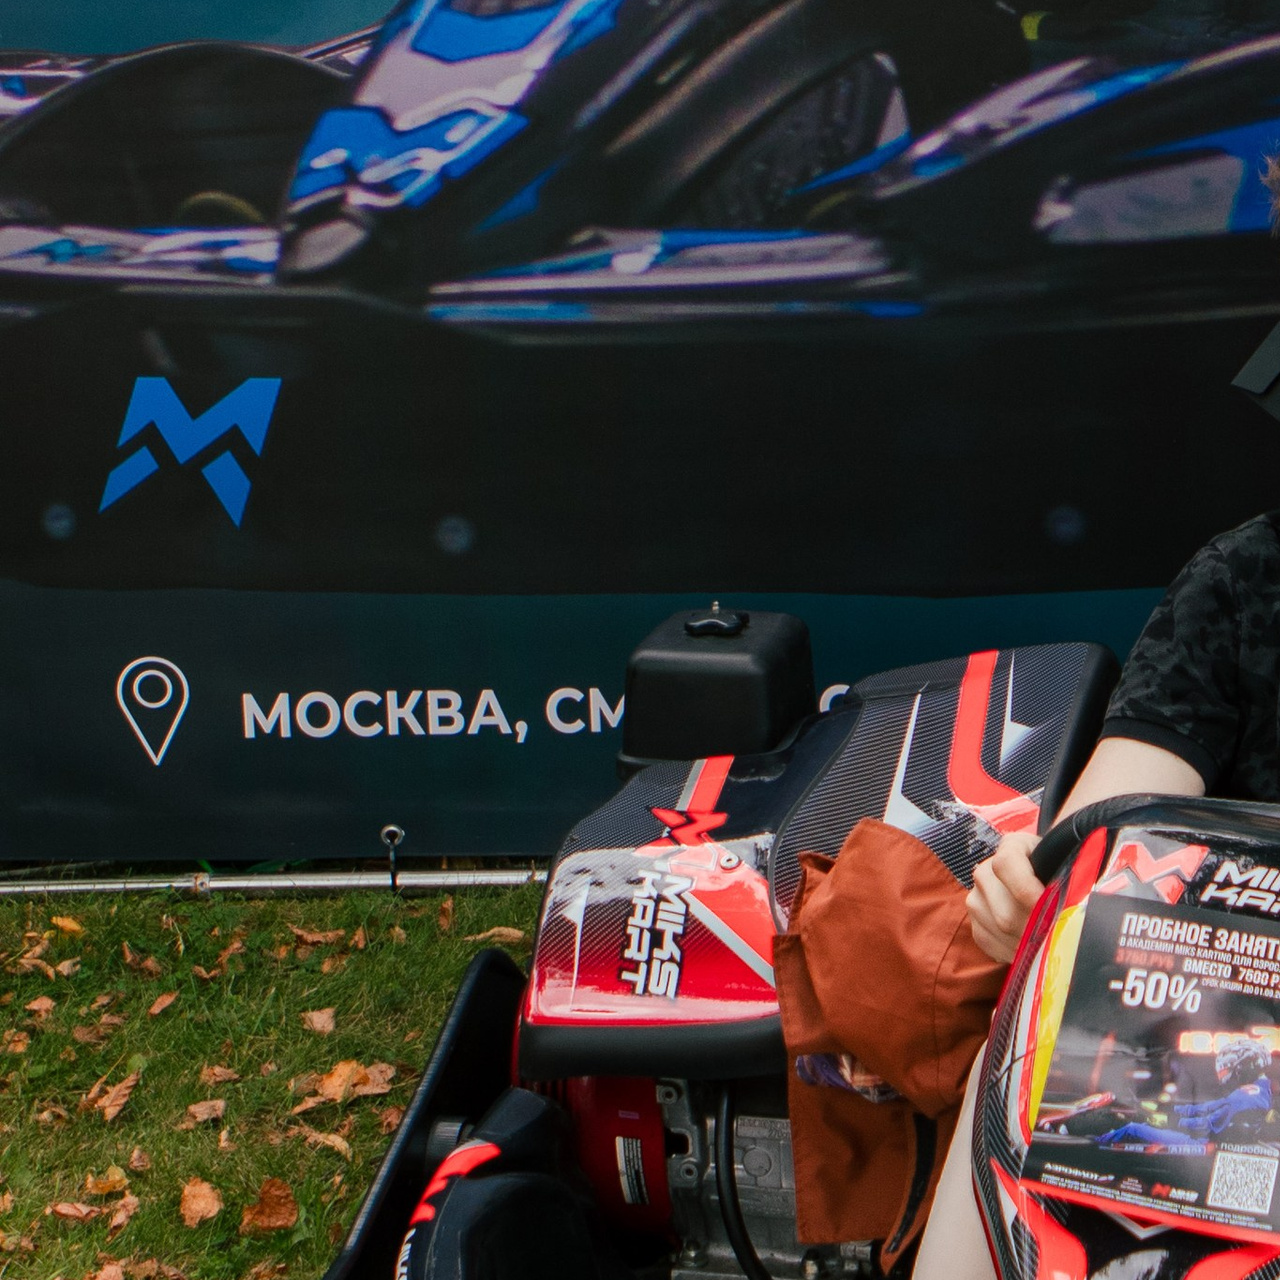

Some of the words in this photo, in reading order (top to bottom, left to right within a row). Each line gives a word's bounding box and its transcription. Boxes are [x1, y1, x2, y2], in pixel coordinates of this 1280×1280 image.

[242, 688, 528, 744] МОСКВА,
[621, 869, 662, 995] KART
[648, 874, 693, 1001] MIKS
[1121, 912, 1213, 947] ПРОБНОЕ
[1126, 936, 1174, 953] АКАДЕМИИ
[1174, 943, 1196, 957] MIKS
[1108, 968, 1203, 1014] -50%
[1182, 958, 1232, 978] ВМЕСТО
